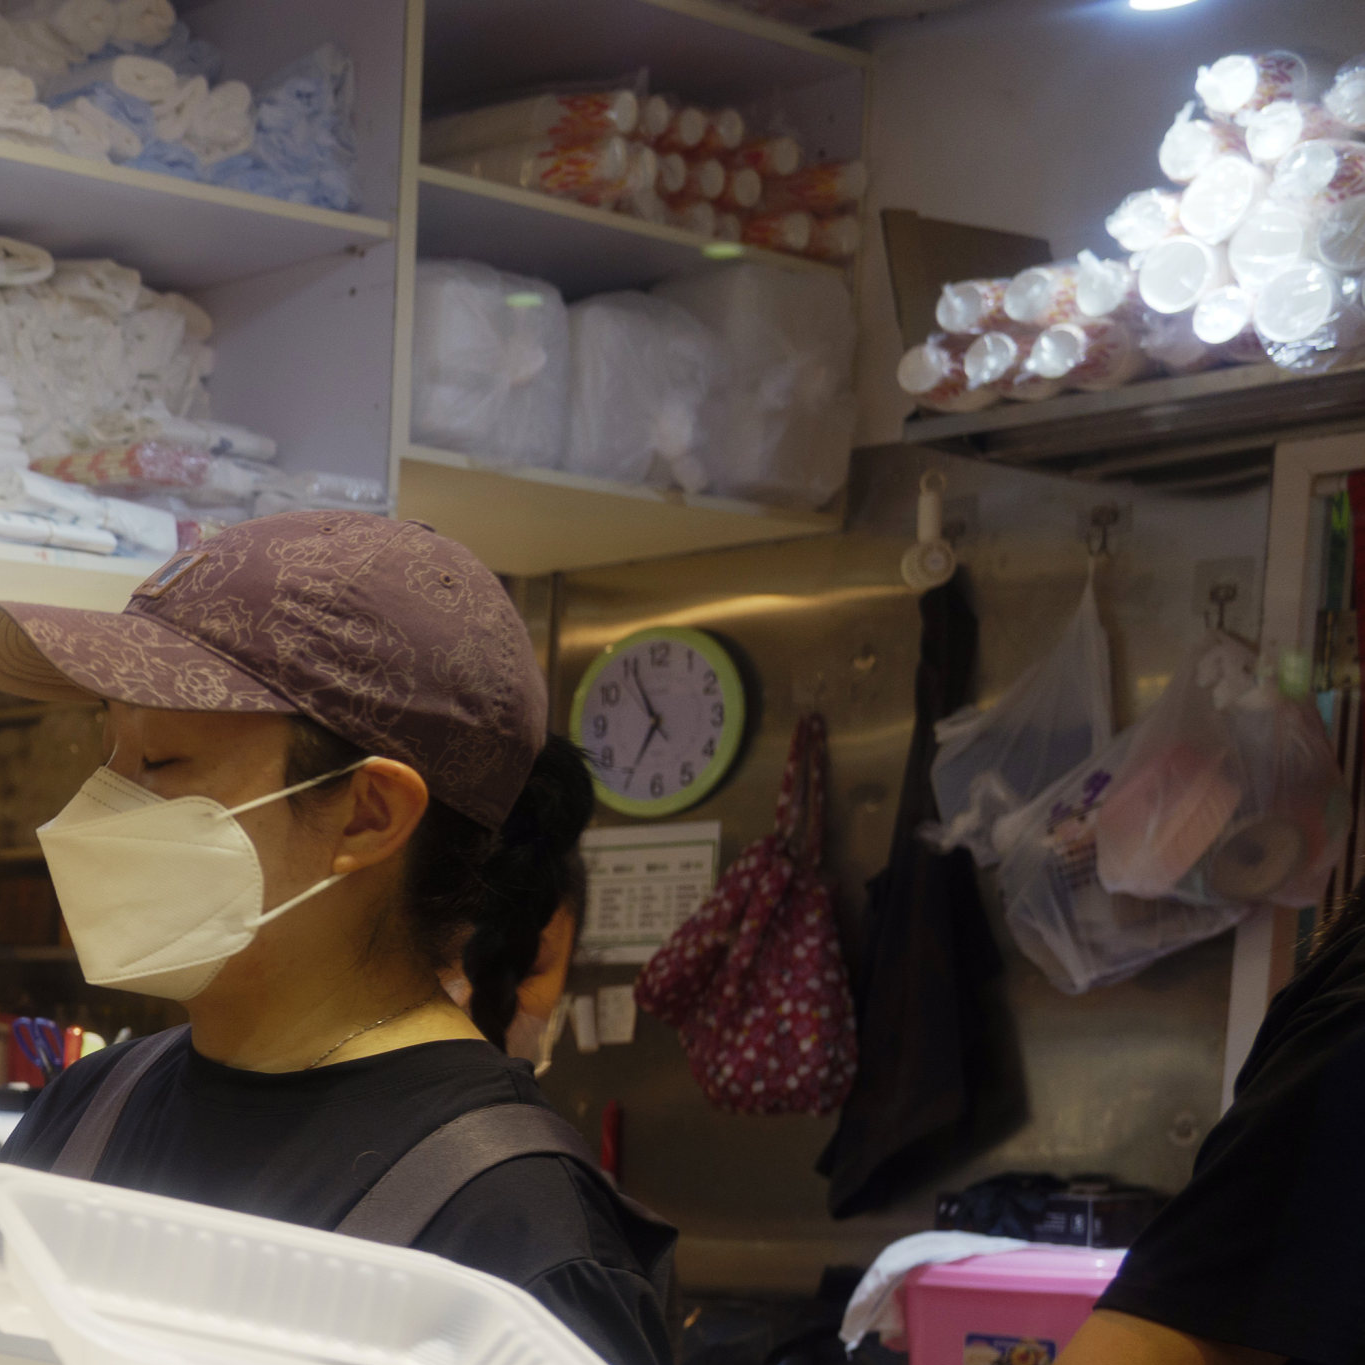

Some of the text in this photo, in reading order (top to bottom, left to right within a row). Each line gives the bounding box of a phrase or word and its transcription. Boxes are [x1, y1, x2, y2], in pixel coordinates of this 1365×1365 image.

[650, 641, 671, 667] 12
[687, 647, 694, 672] 1
[600, 681, 620, 707] 10
[702, 668, 717, 695] 2
[593, 714, 608, 739] 9
[710, 701, 724, 728] 3
[702, 737, 716, 759] 4
[650, 772, 664, 798] 6
[679, 761, 695, 787] 5
